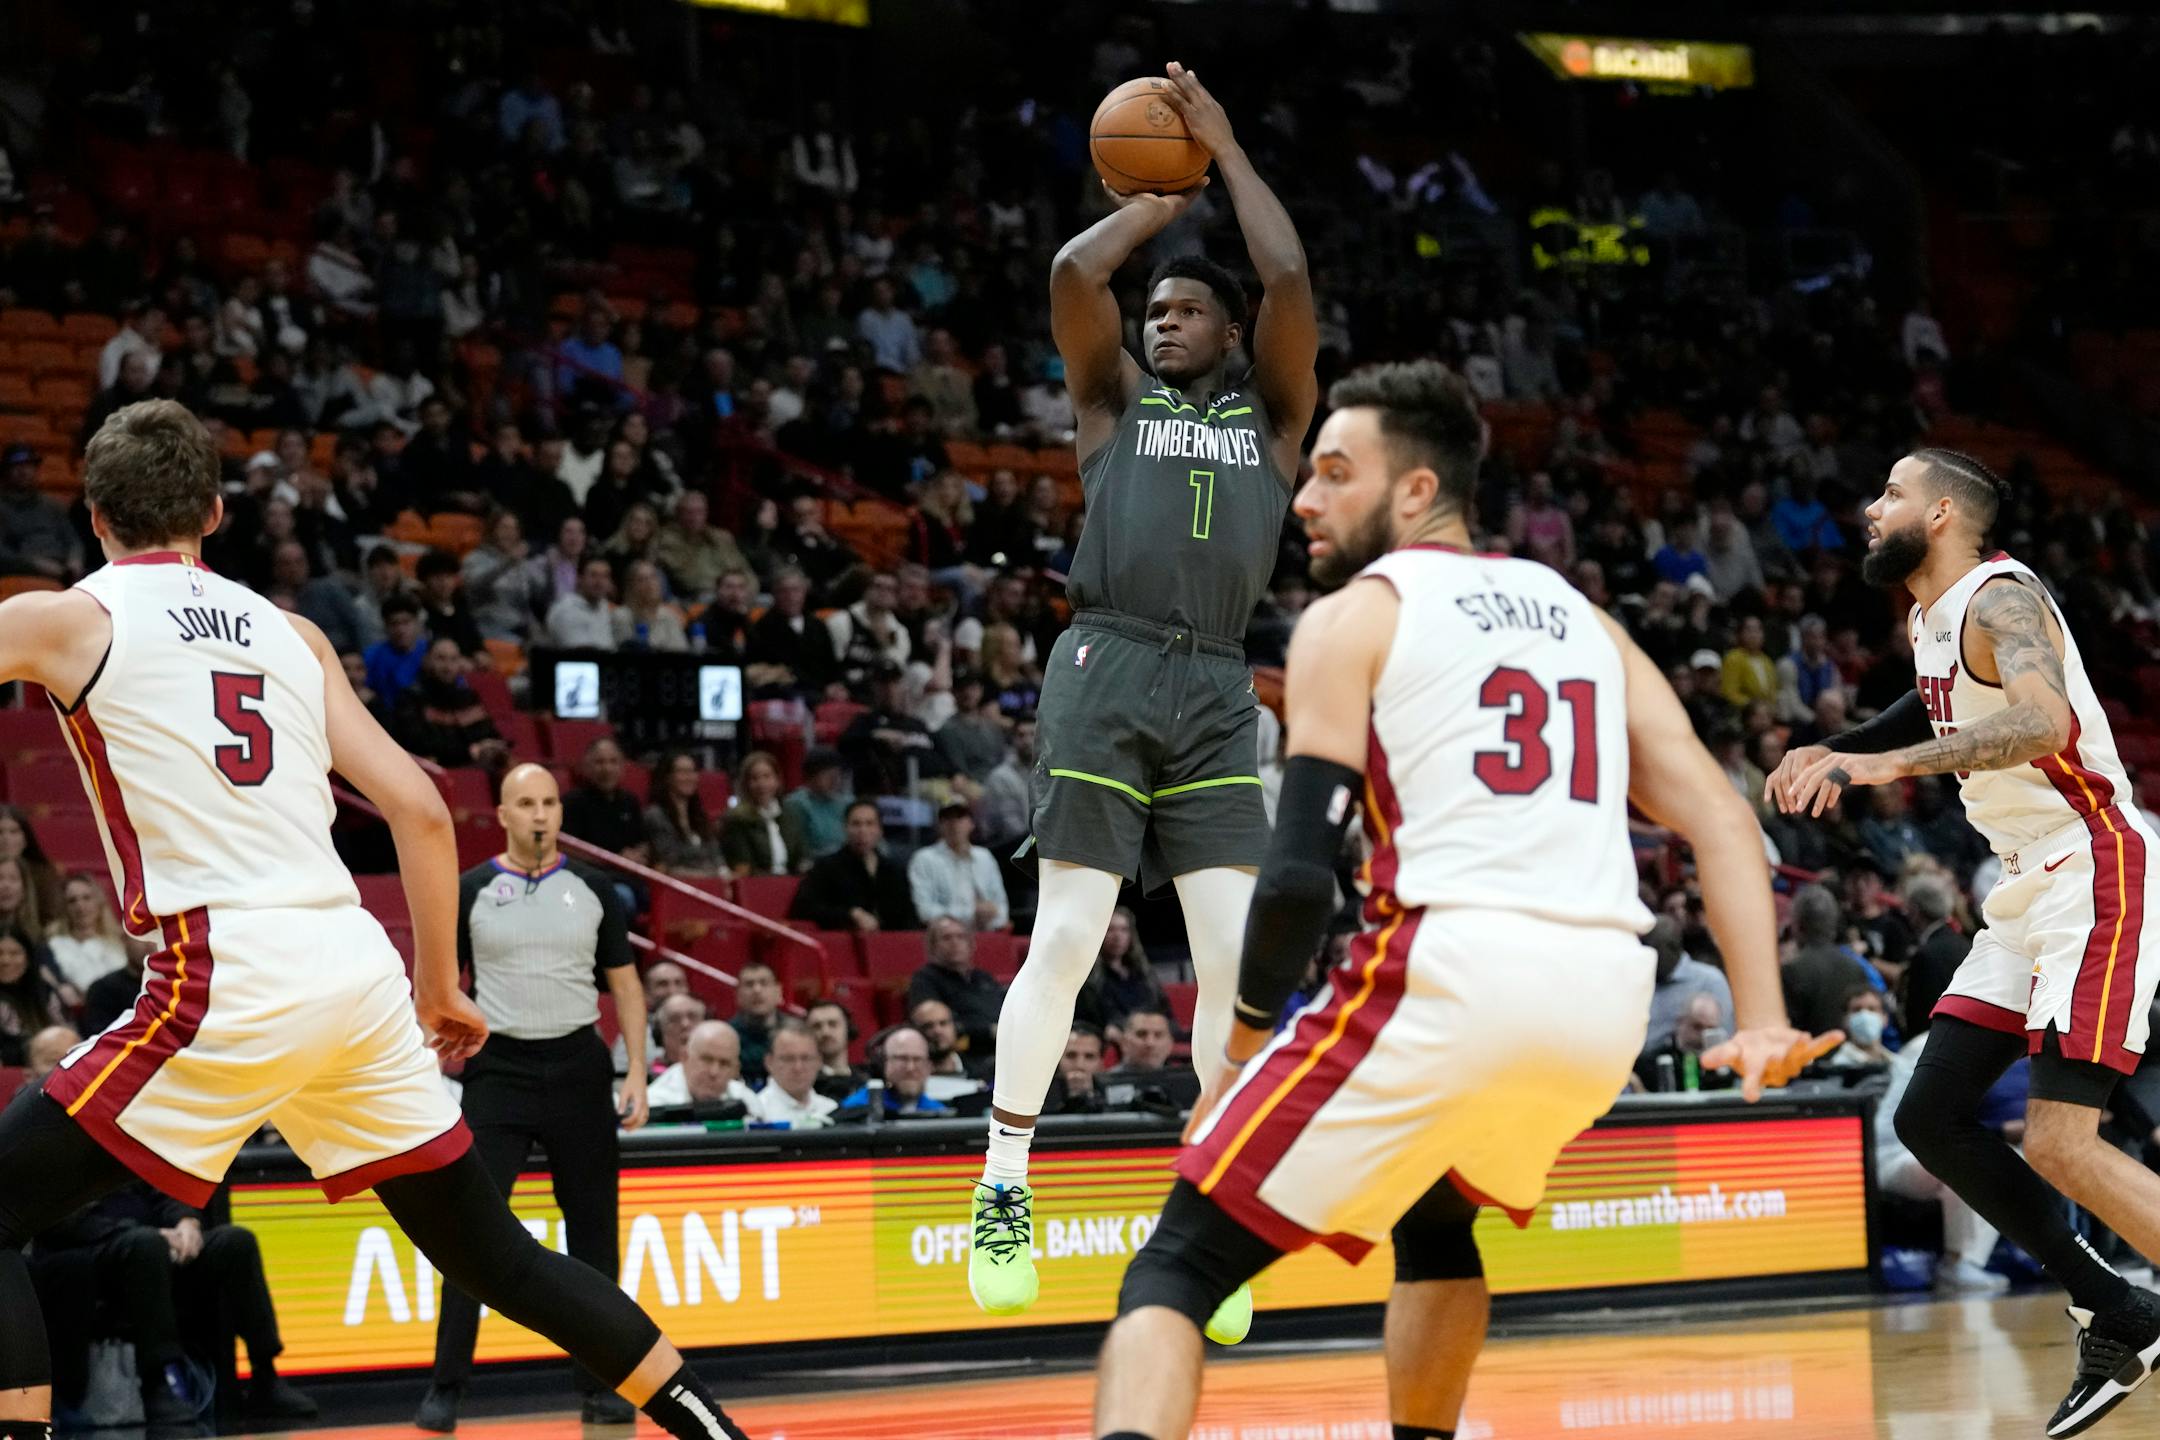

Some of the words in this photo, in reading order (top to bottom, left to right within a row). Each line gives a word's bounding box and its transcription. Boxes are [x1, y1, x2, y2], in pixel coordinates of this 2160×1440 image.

[1135, 418, 1260, 470] TIMBERWOLVES
[1189, 469, 1215, 540] 1
[167, 606, 251, 649] JOVIĆ
[1935, 631, 1952, 643] UKG
[1917, 659, 1959, 723] EAT
[210, 669, 274, 787] 5
[1472, 664, 1599, 805] 31
[1046, 1214, 1128, 1258] BANK
[1129, 1213, 1163, 1252] O
[1550, 1182, 1787, 1231] amerantbank.com
[343, 1206, 797, 1326] AANT
